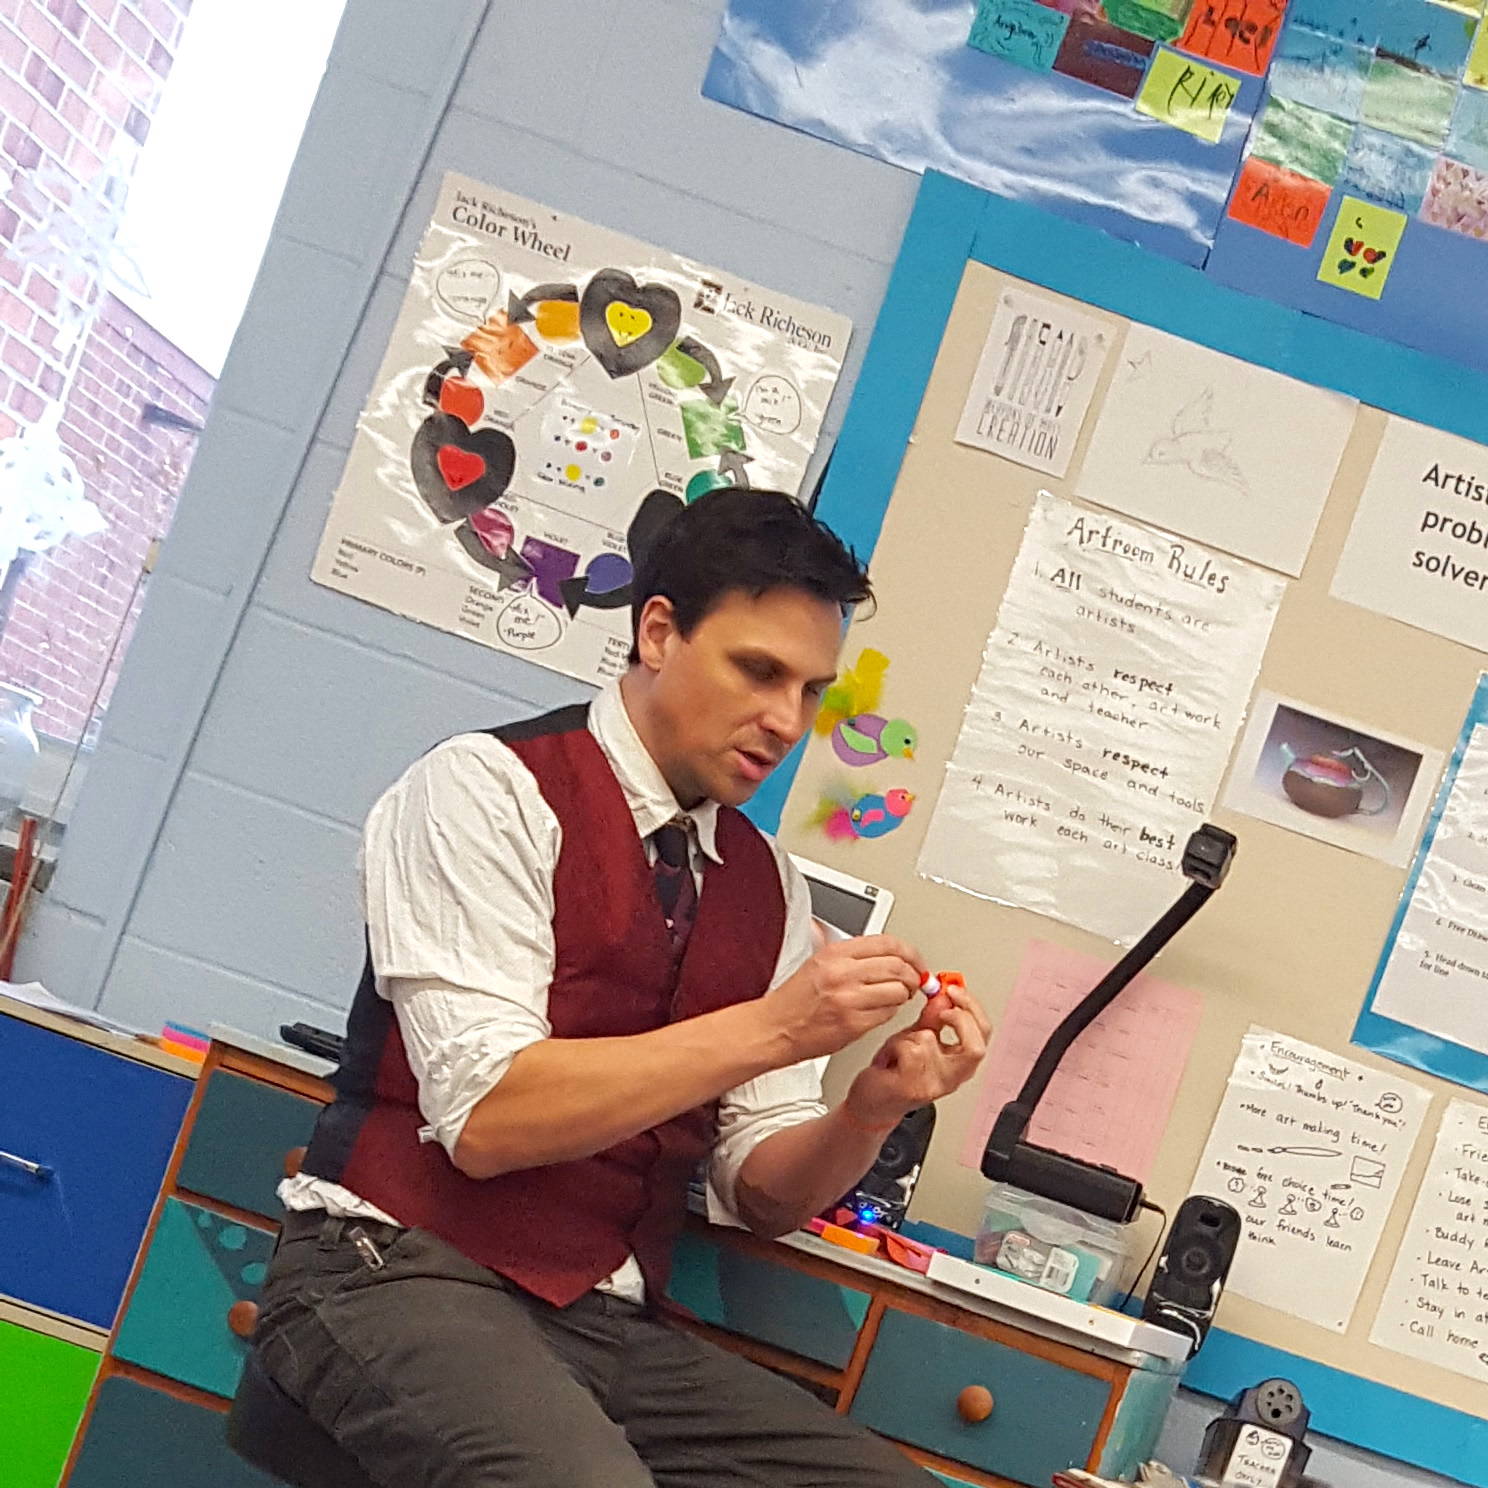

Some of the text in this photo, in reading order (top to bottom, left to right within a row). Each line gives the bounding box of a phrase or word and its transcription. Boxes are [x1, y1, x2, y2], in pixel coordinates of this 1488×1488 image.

[452, 206, 571, 262] Color Wheel
[759, 307, 832, 348] Richeson
[976, 411, 1058, 461] CREATION
[1066, 516, 1230, 595] Artroom Rules
[1050, 567, 1082, 592] All
[1098, 586, 1173, 621] students
[1076, 605, 1136, 634] artists
[1033, 639, 1174, 697] Artists respect
[1040, 665, 1072, 685] each
[1040, 686, 1150, 730] and teacher
[1018, 718, 1170, 780] Artists respect
[1018, 745, 1046, 761] our
[1063, 758, 1109, 784] space
[1126, 778, 1160, 798] and
[994, 783, 1051, 811] Artists
[1068, 806, 1087, 822] do
[1138, 826, 1176, 852] best
[1003, 809, 1038, 829] work
[1057, 825, 1089, 844] each
[1448, 920, 1466, 933] Free
[1467, 928, 1488, 943] Draw
[1435, 953, 1457, 968] Head
[1457, 962, 1481, 977] down
[1270, 1041, 1350, 1080] Encouragement
[1276, 1113, 1297, 1126] art
[1302, 1119, 1340, 1143] making
[1351, 1132, 1387, 1153] time!
[1282, 1175, 1315, 1197] choice
[1448, 1190, 1472, 1207] Lose
[1276, 1222, 1316, 1242] friends
[1455, 1212, 1475, 1224] art
[1435, 1227, 1475, 1250] Buddy
[1427, 1251, 1462, 1272] Leave
[1421, 1274, 1449, 1291] Talk
[1457, 1282, 1469, 1296] to
[1416, 1296, 1444, 1320] Stay
[1454, 1306, 1465, 1319] in
[1409, 1320, 1479, 1349] Call home
